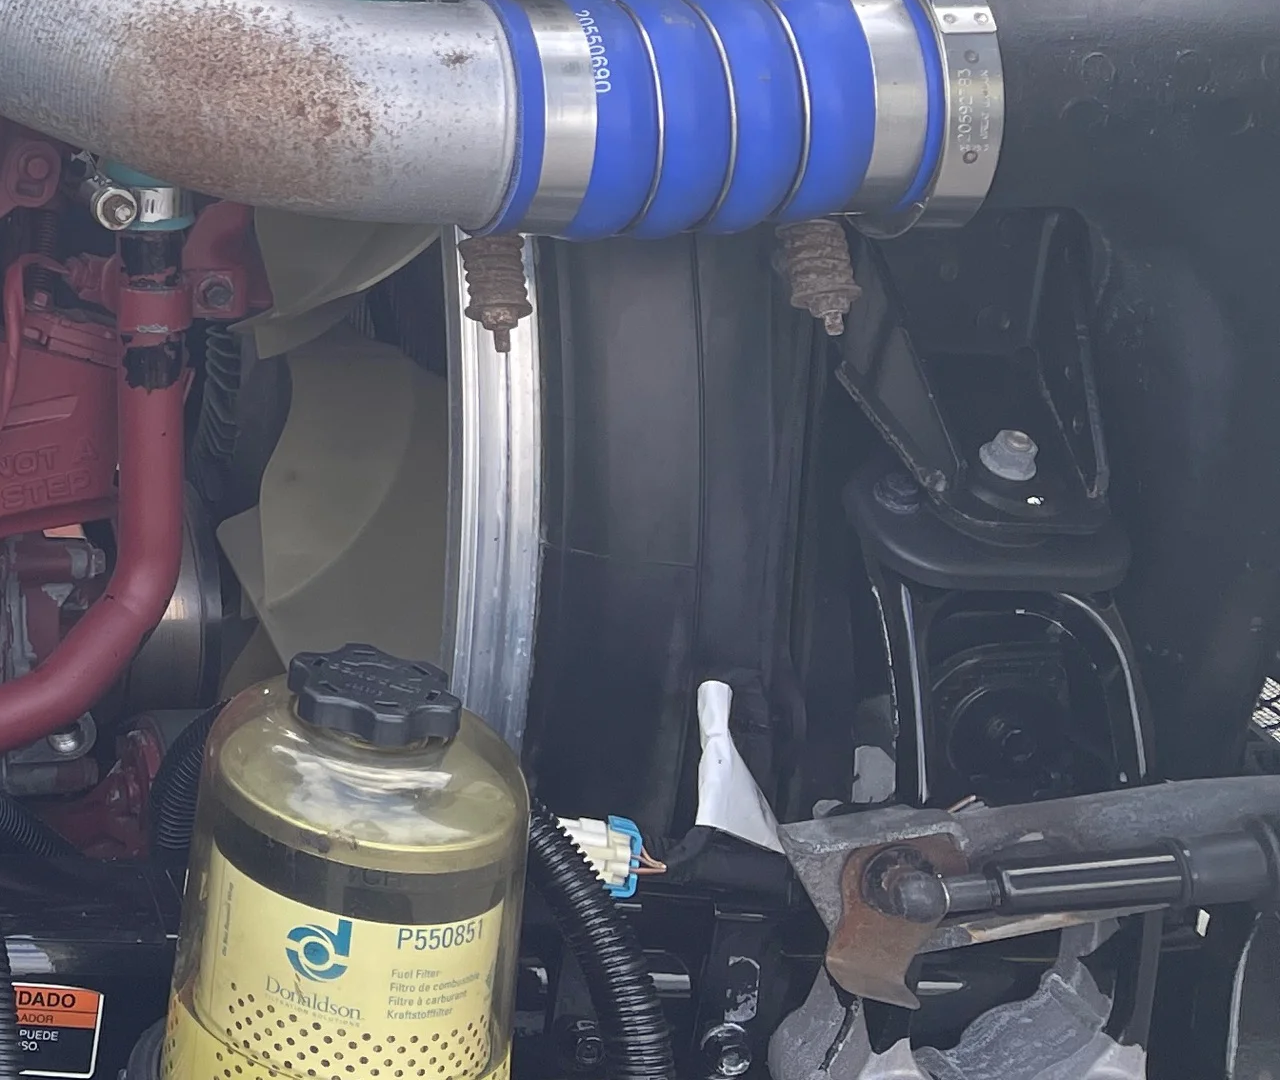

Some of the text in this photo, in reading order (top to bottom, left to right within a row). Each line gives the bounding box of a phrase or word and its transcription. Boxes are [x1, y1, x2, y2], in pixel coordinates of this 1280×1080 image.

[1, 468, 91, 510] STEP
[397, 918, 483, 951] P550851
[391, 969, 441, 980] Fuel Filter
[390, 982, 416, 993] Filtro
[418, 982, 431, 993] de
[18, 990, 76, 1008] DADO
[266, 975, 361, 1021] Donaldson
[388, 996, 414, 1007] Filtre
[20, 1013, 54, 1024] ADOR
[19, 1029, 59, 1042] PUEDE
[19, 1040, 40, 1052] SO.
